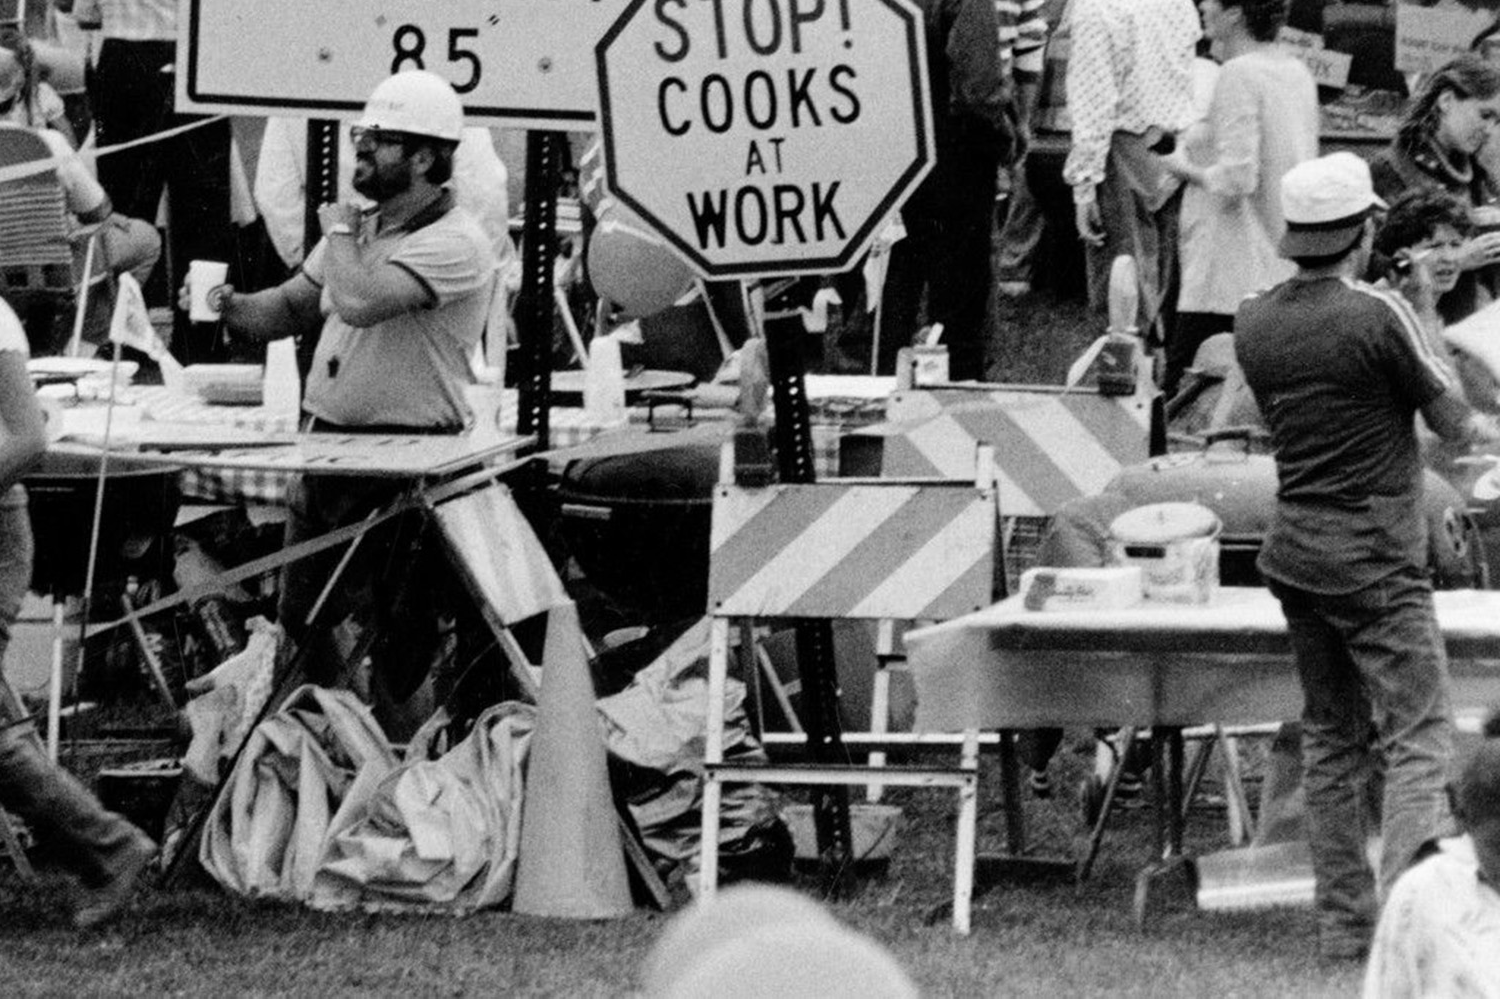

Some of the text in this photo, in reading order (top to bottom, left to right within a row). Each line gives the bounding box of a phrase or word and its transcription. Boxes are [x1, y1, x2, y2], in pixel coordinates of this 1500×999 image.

[657, 63, 861, 137] COOKS
[745, 137, 786, 176] AT
[686, 180, 848, 251] WORK
